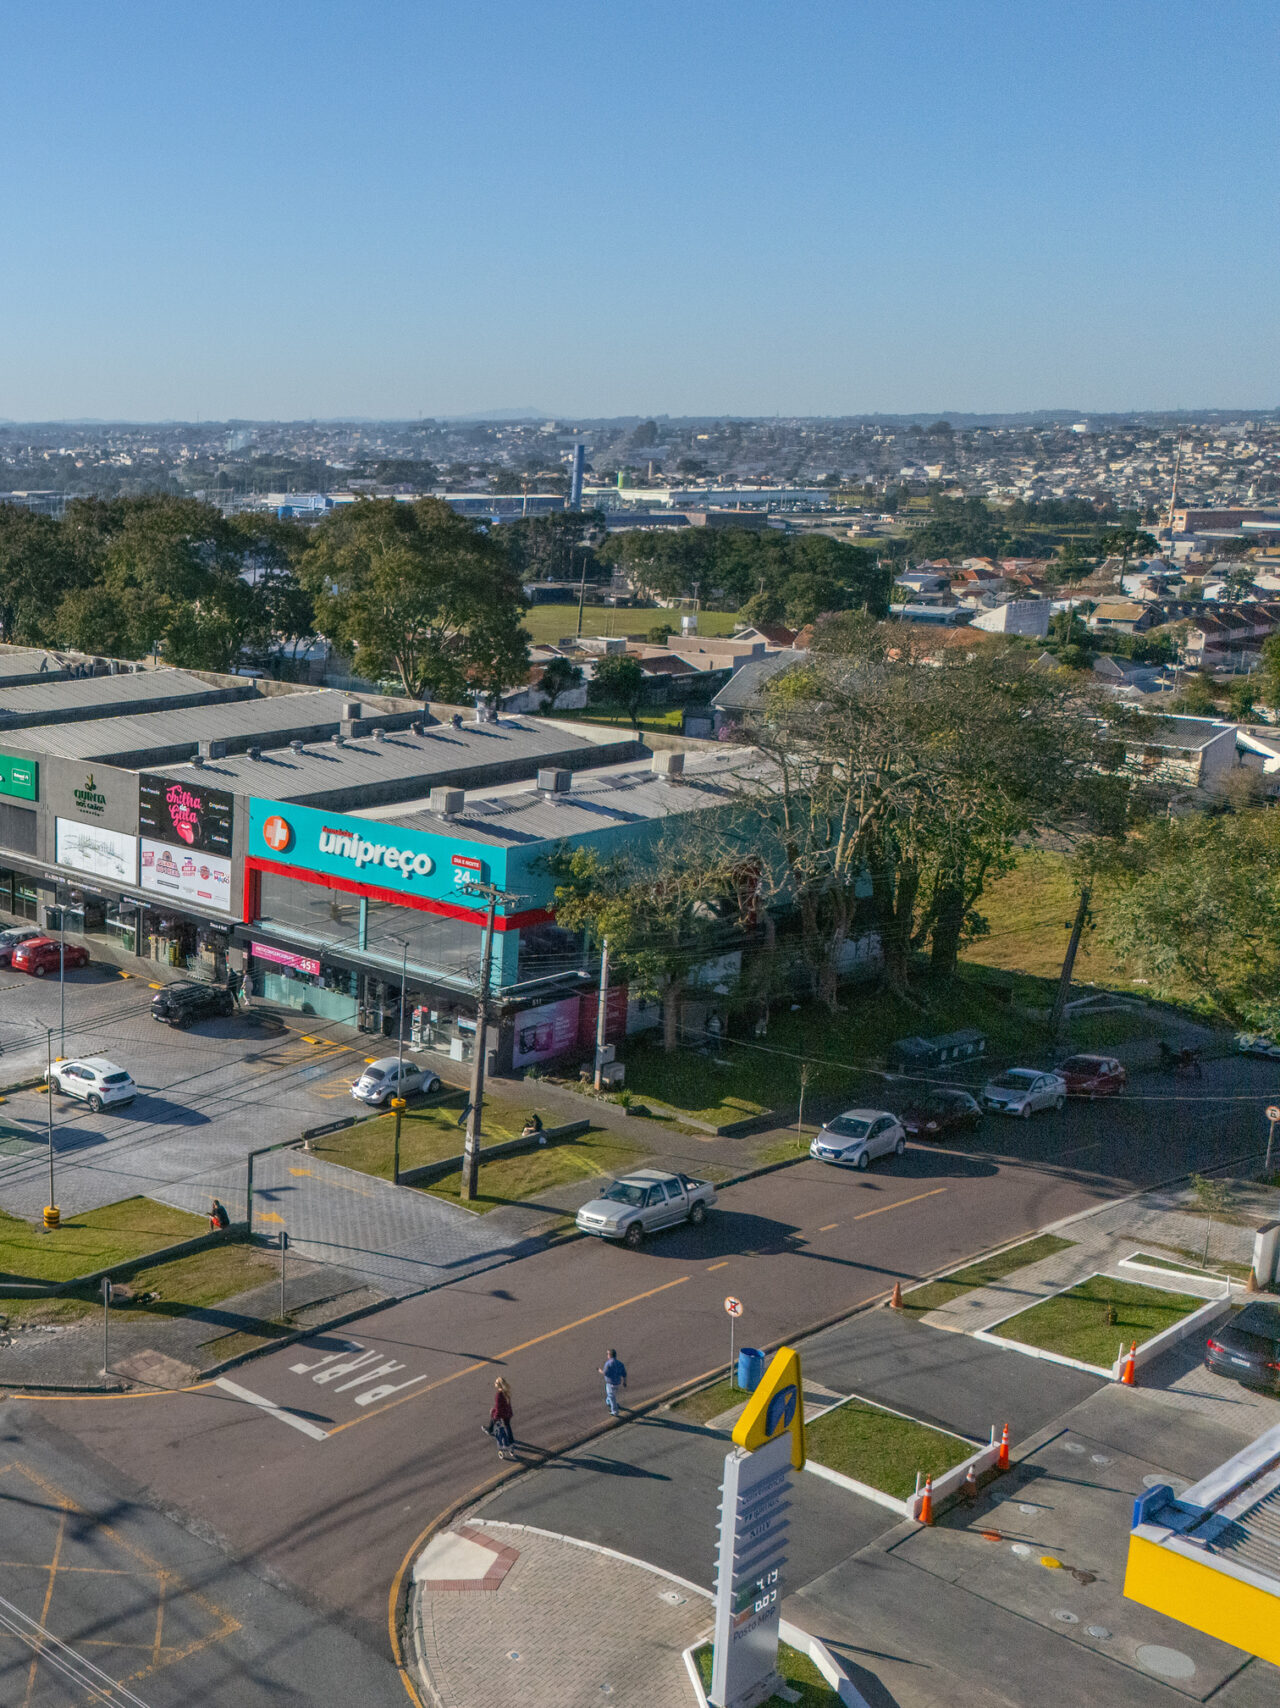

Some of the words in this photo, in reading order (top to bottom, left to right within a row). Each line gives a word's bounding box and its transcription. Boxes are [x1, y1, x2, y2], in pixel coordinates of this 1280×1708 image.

[73, 789, 107, 806] QUINTA
[166, 784, 201, 810] Trilha
[168, 804, 198, 827] Gula
[319, 833, 432, 878] unipreço
[287, 1340, 428, 1407] PARE
[733, 1620, 758, 1645] Posto
